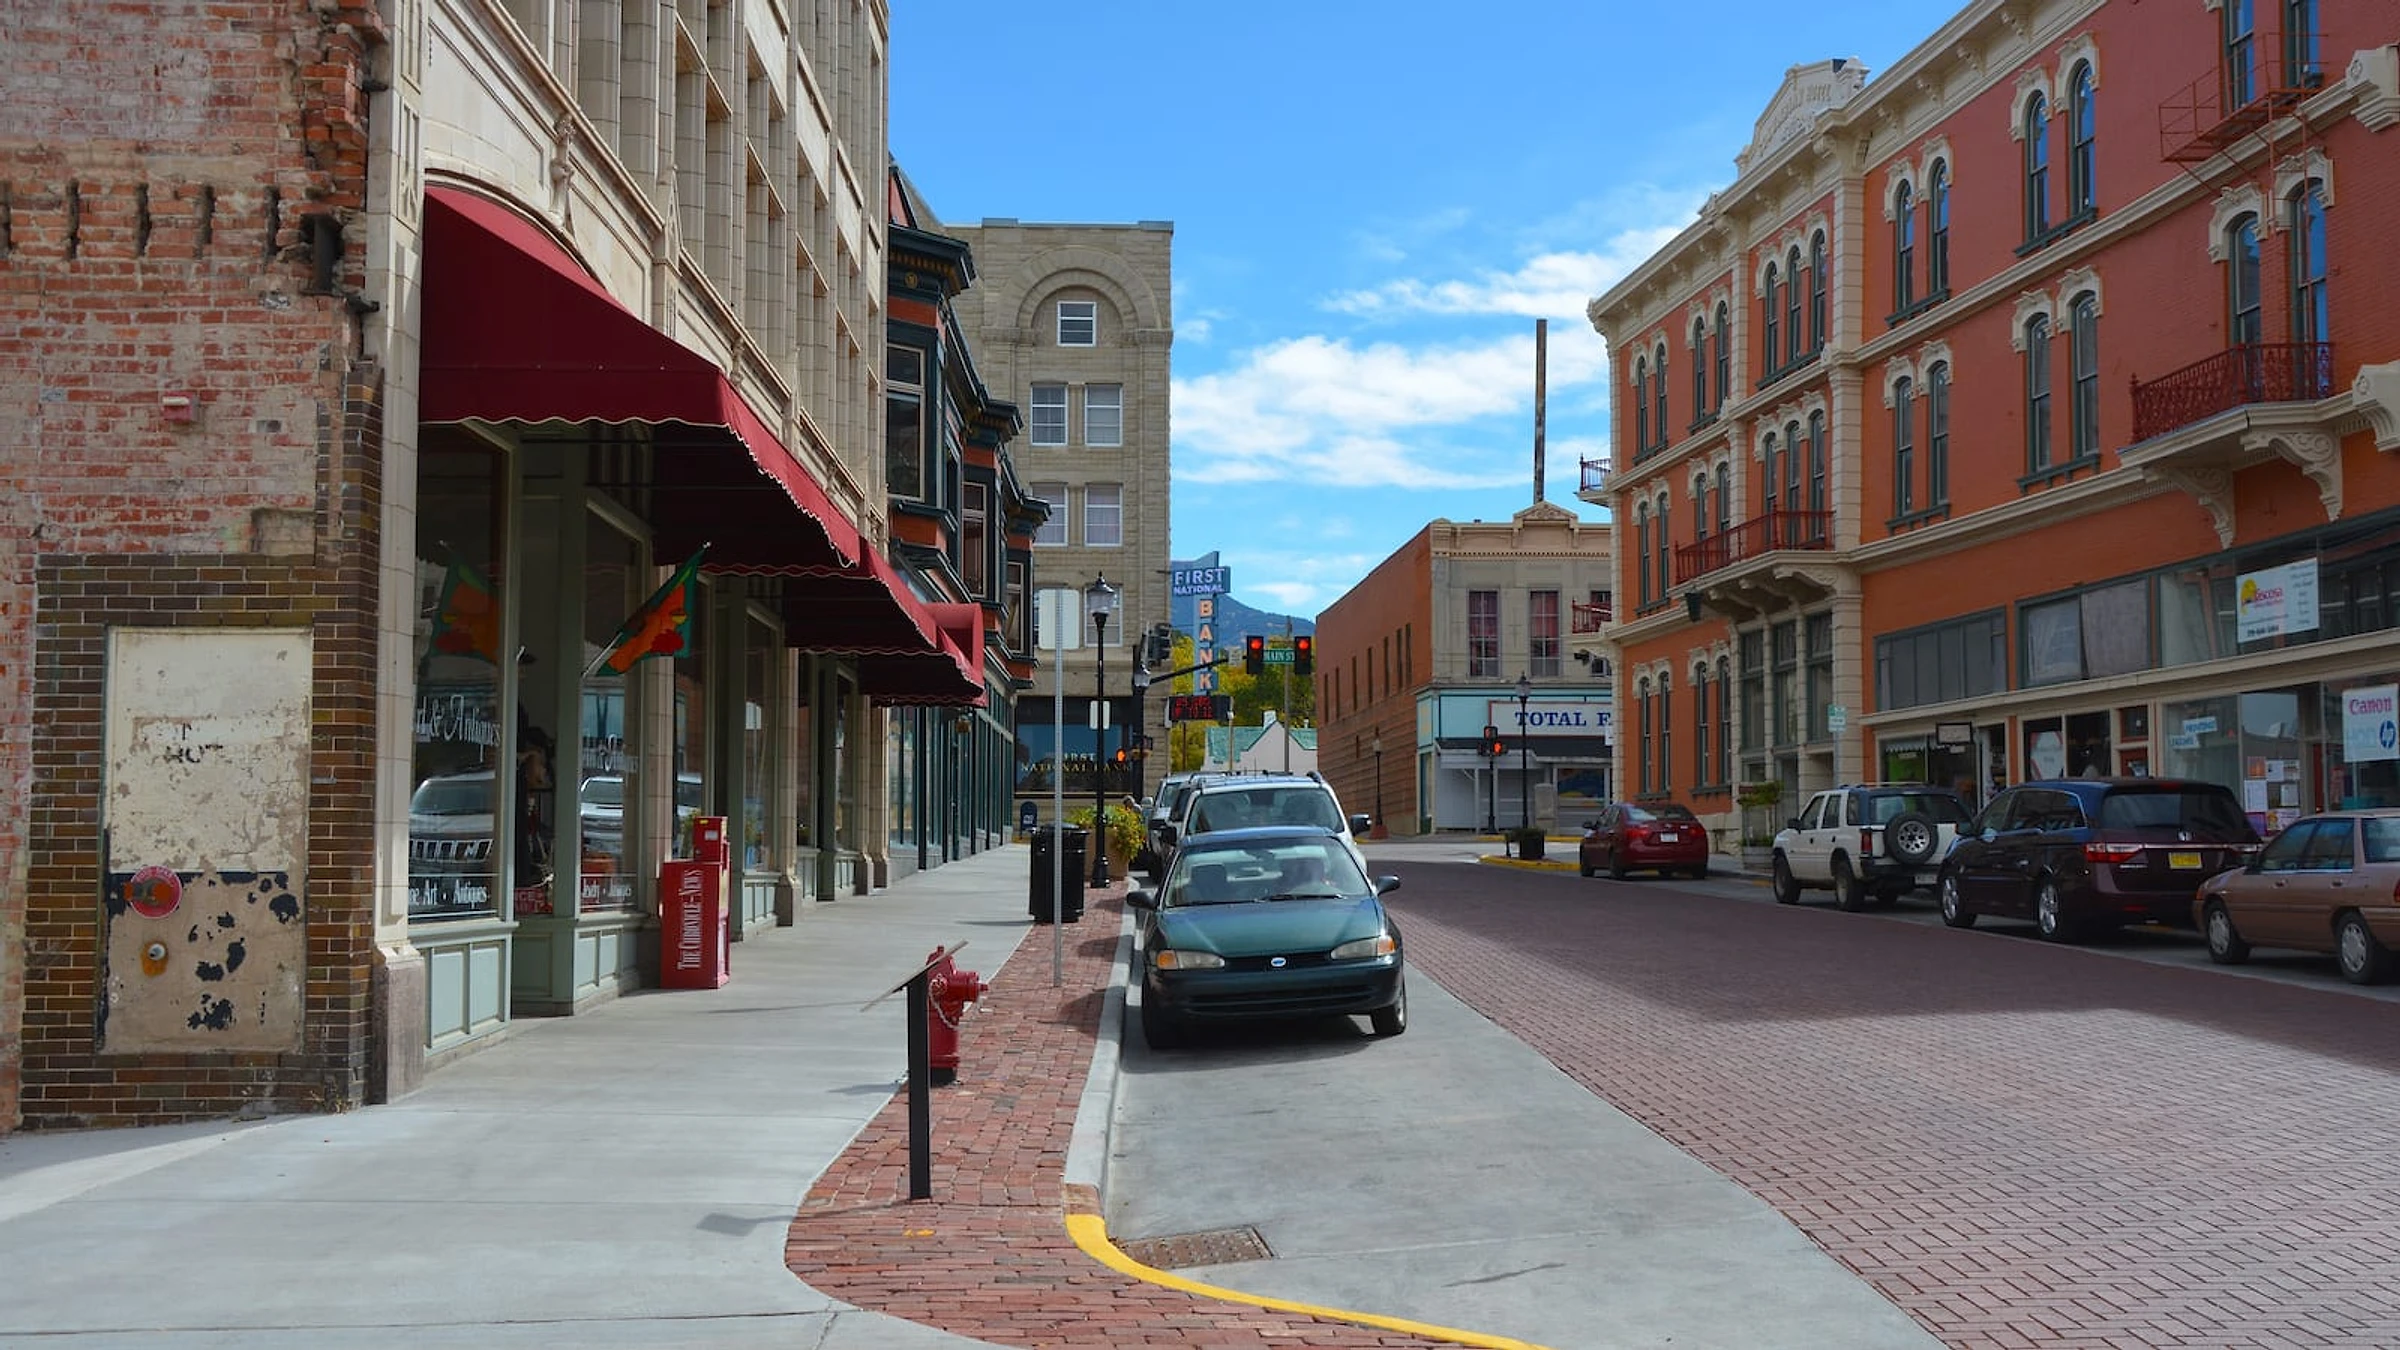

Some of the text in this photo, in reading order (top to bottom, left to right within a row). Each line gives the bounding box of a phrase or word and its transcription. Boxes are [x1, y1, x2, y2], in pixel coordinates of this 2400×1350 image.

[1174, 568, 1225, 585] FIRST
[1173, 584, 1225, 596] NATIONAL
[1199, 599, 1213, 690] BANK
[1263, 650, 1284, 661] MAIN
[2350, 696, 2392, 715] Canon
[1515, 712, 1587, 727] TOTAL
[444, 694, 501, 763] Antiques
[1062, 752, 1096, 762] IRST
[1020, 763, 1130, 773] NATINAL ANK
[422, 879, 438, 906] Art
[453, 878, 489, 910] Antiques
